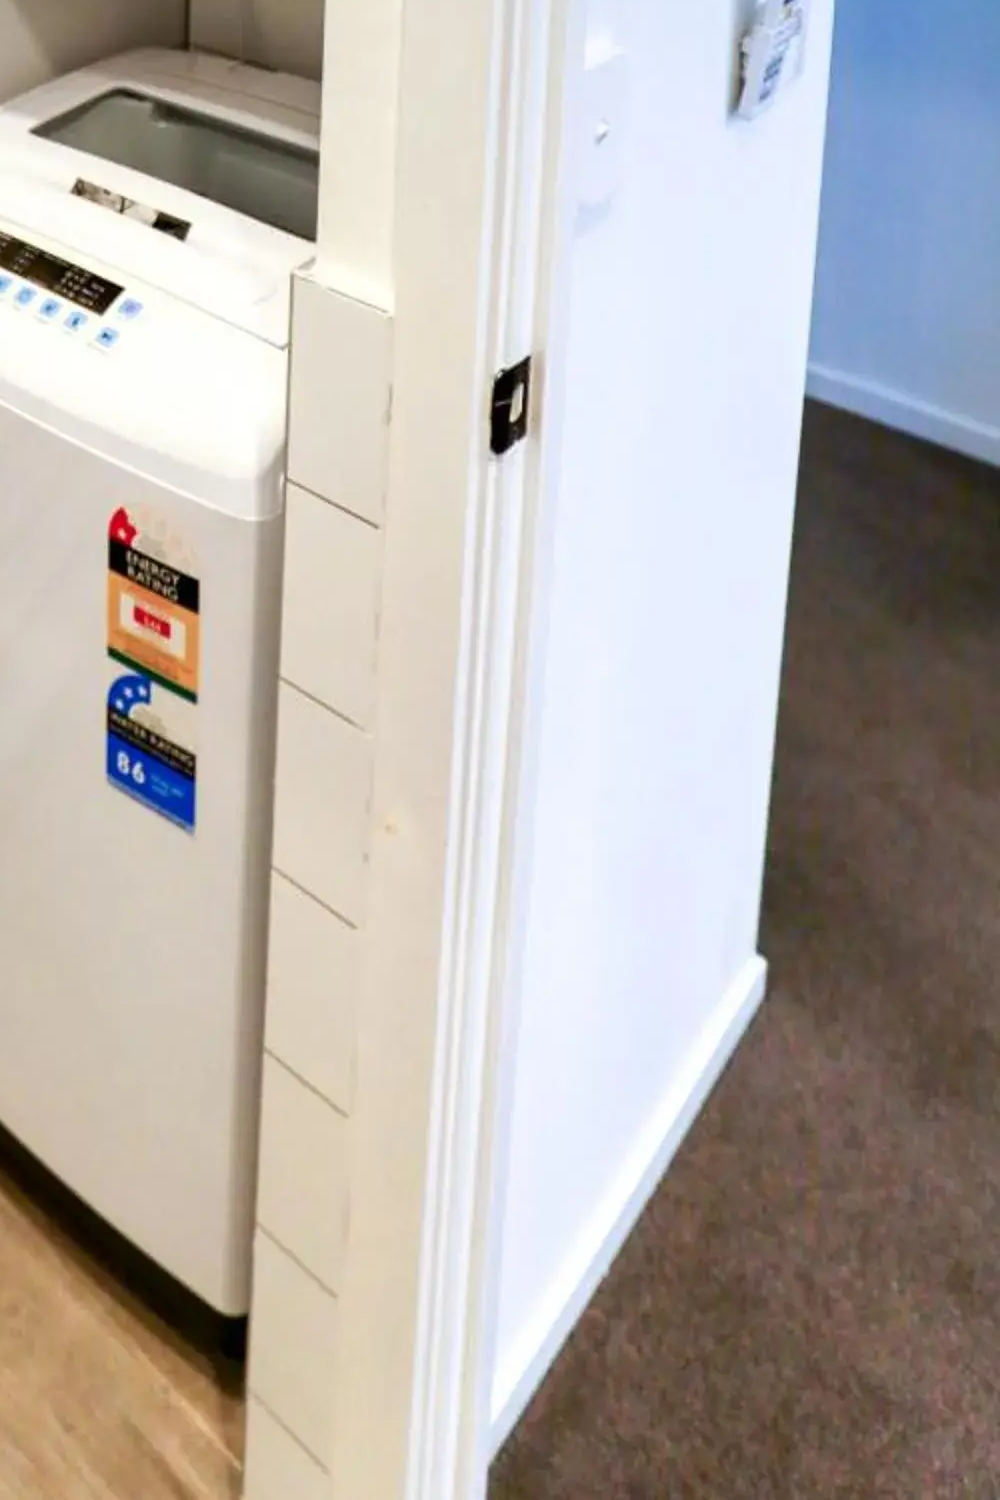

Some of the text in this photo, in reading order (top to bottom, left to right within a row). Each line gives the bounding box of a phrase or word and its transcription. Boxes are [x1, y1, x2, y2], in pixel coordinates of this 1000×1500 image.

[125, 550, 181, 585] ENERGY
[127, 566, 179, 601] RATING
[116, 749, 146, 785] 86
